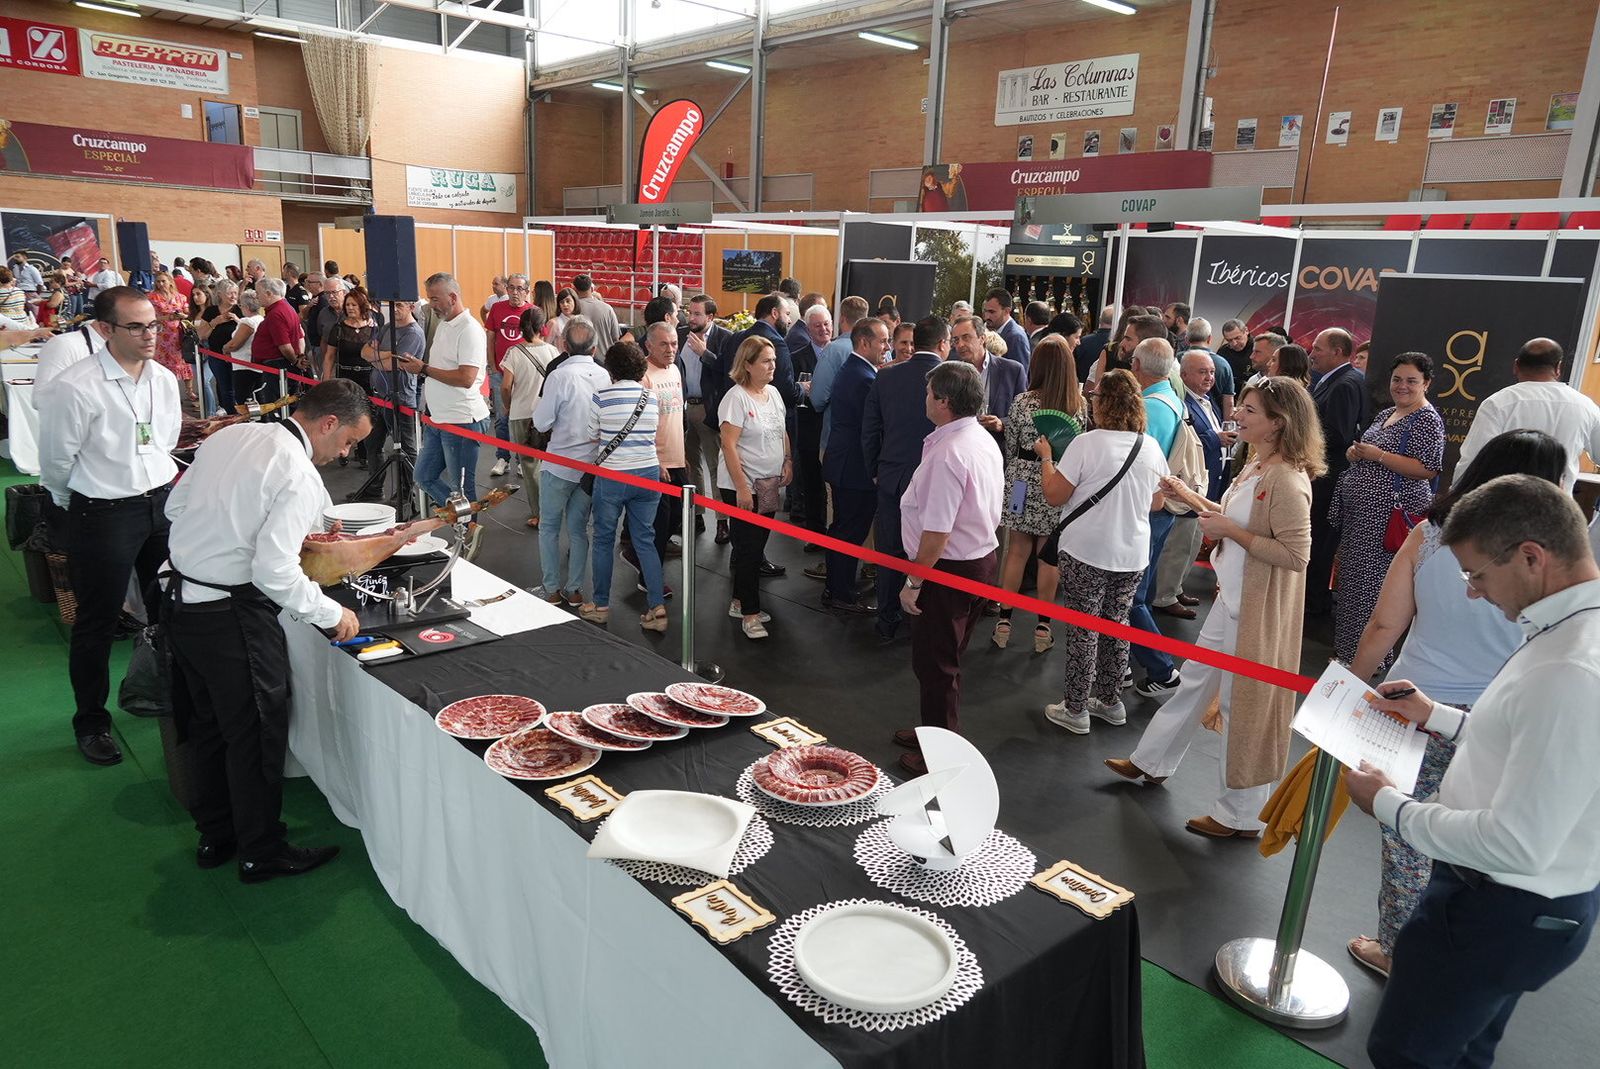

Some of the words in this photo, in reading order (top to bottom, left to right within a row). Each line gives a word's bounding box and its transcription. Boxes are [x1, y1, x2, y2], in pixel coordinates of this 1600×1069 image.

[96, 40, 216, 66] ROSYPAN
[17, 60, 67, 71] CORDOBA
[112, 60, 156, 71] PASTELERIA
[166, 67, 207, 77] PANADERIA
[1030, 68, 1057, 92] Las
[1064, 61, 1135, 88] Columnas
[1032, 94, 1050, 106] BAR
[1063, 85, 1129, 104] RESTAURANTE
[1019, 113, 1047, 122] BAUTIZOS
[1056, 108, 1104, 119] CELEBRACIONES
[72, 133, 147, 154] Cruzcampo
[83, 149, 141, 164] ESPECIAL
[640, 109, 701, 200] Cruzcampo
[1010, 168, 1080, 185] Cruzcampo
[1121, 198, 1157, 212] COVAP
[1206, 260, 1291, 288] Ibéricos
